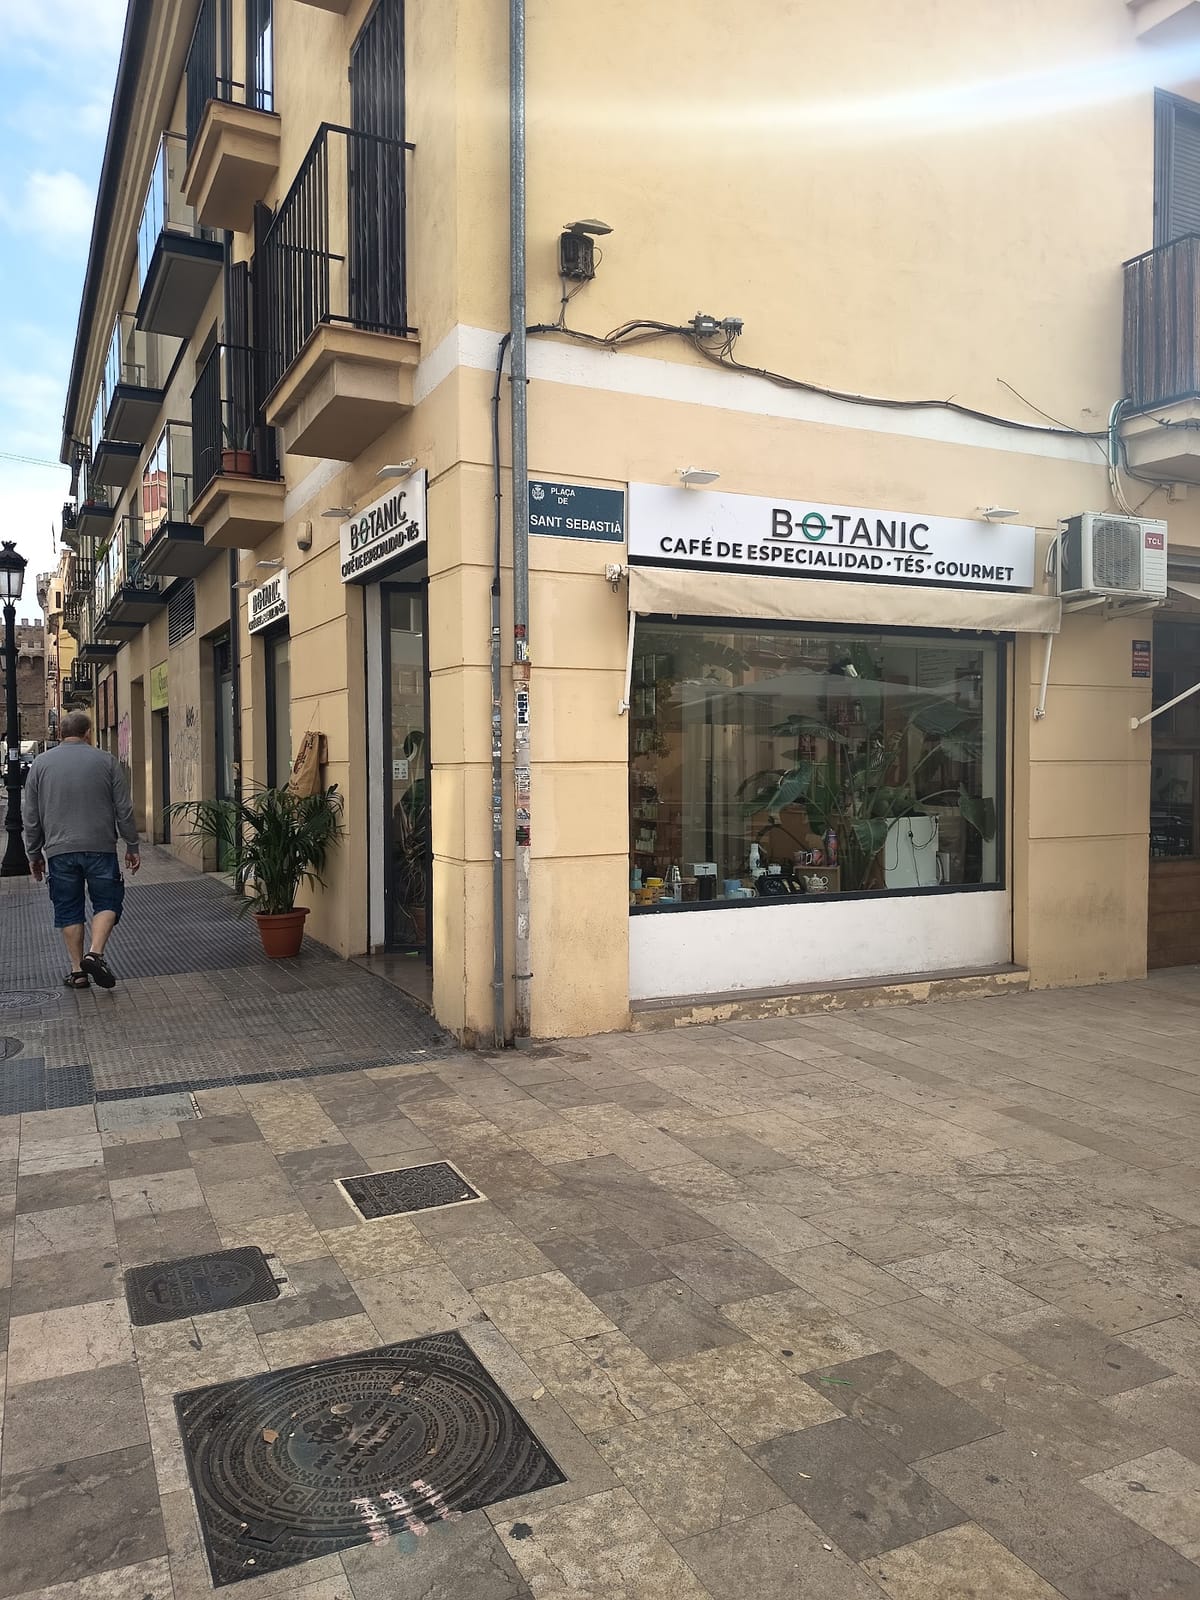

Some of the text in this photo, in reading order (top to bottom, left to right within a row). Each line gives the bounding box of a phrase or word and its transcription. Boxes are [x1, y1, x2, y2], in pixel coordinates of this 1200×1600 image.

[550, 487, 576, 497] PLAÇA
[557, 497, 569, 505] DE
[350, 491, 407, 551] BOTANIC
[530, 514, 622, 534] SANT SEBASTIÀ
[771, 508, 930, 551] BOTANIC
[1146, 536, 1162, 546] TCL
[659, 536, 1014, 581] CAFÉ DE ESPECIALIDAD TÉS GOURMET
